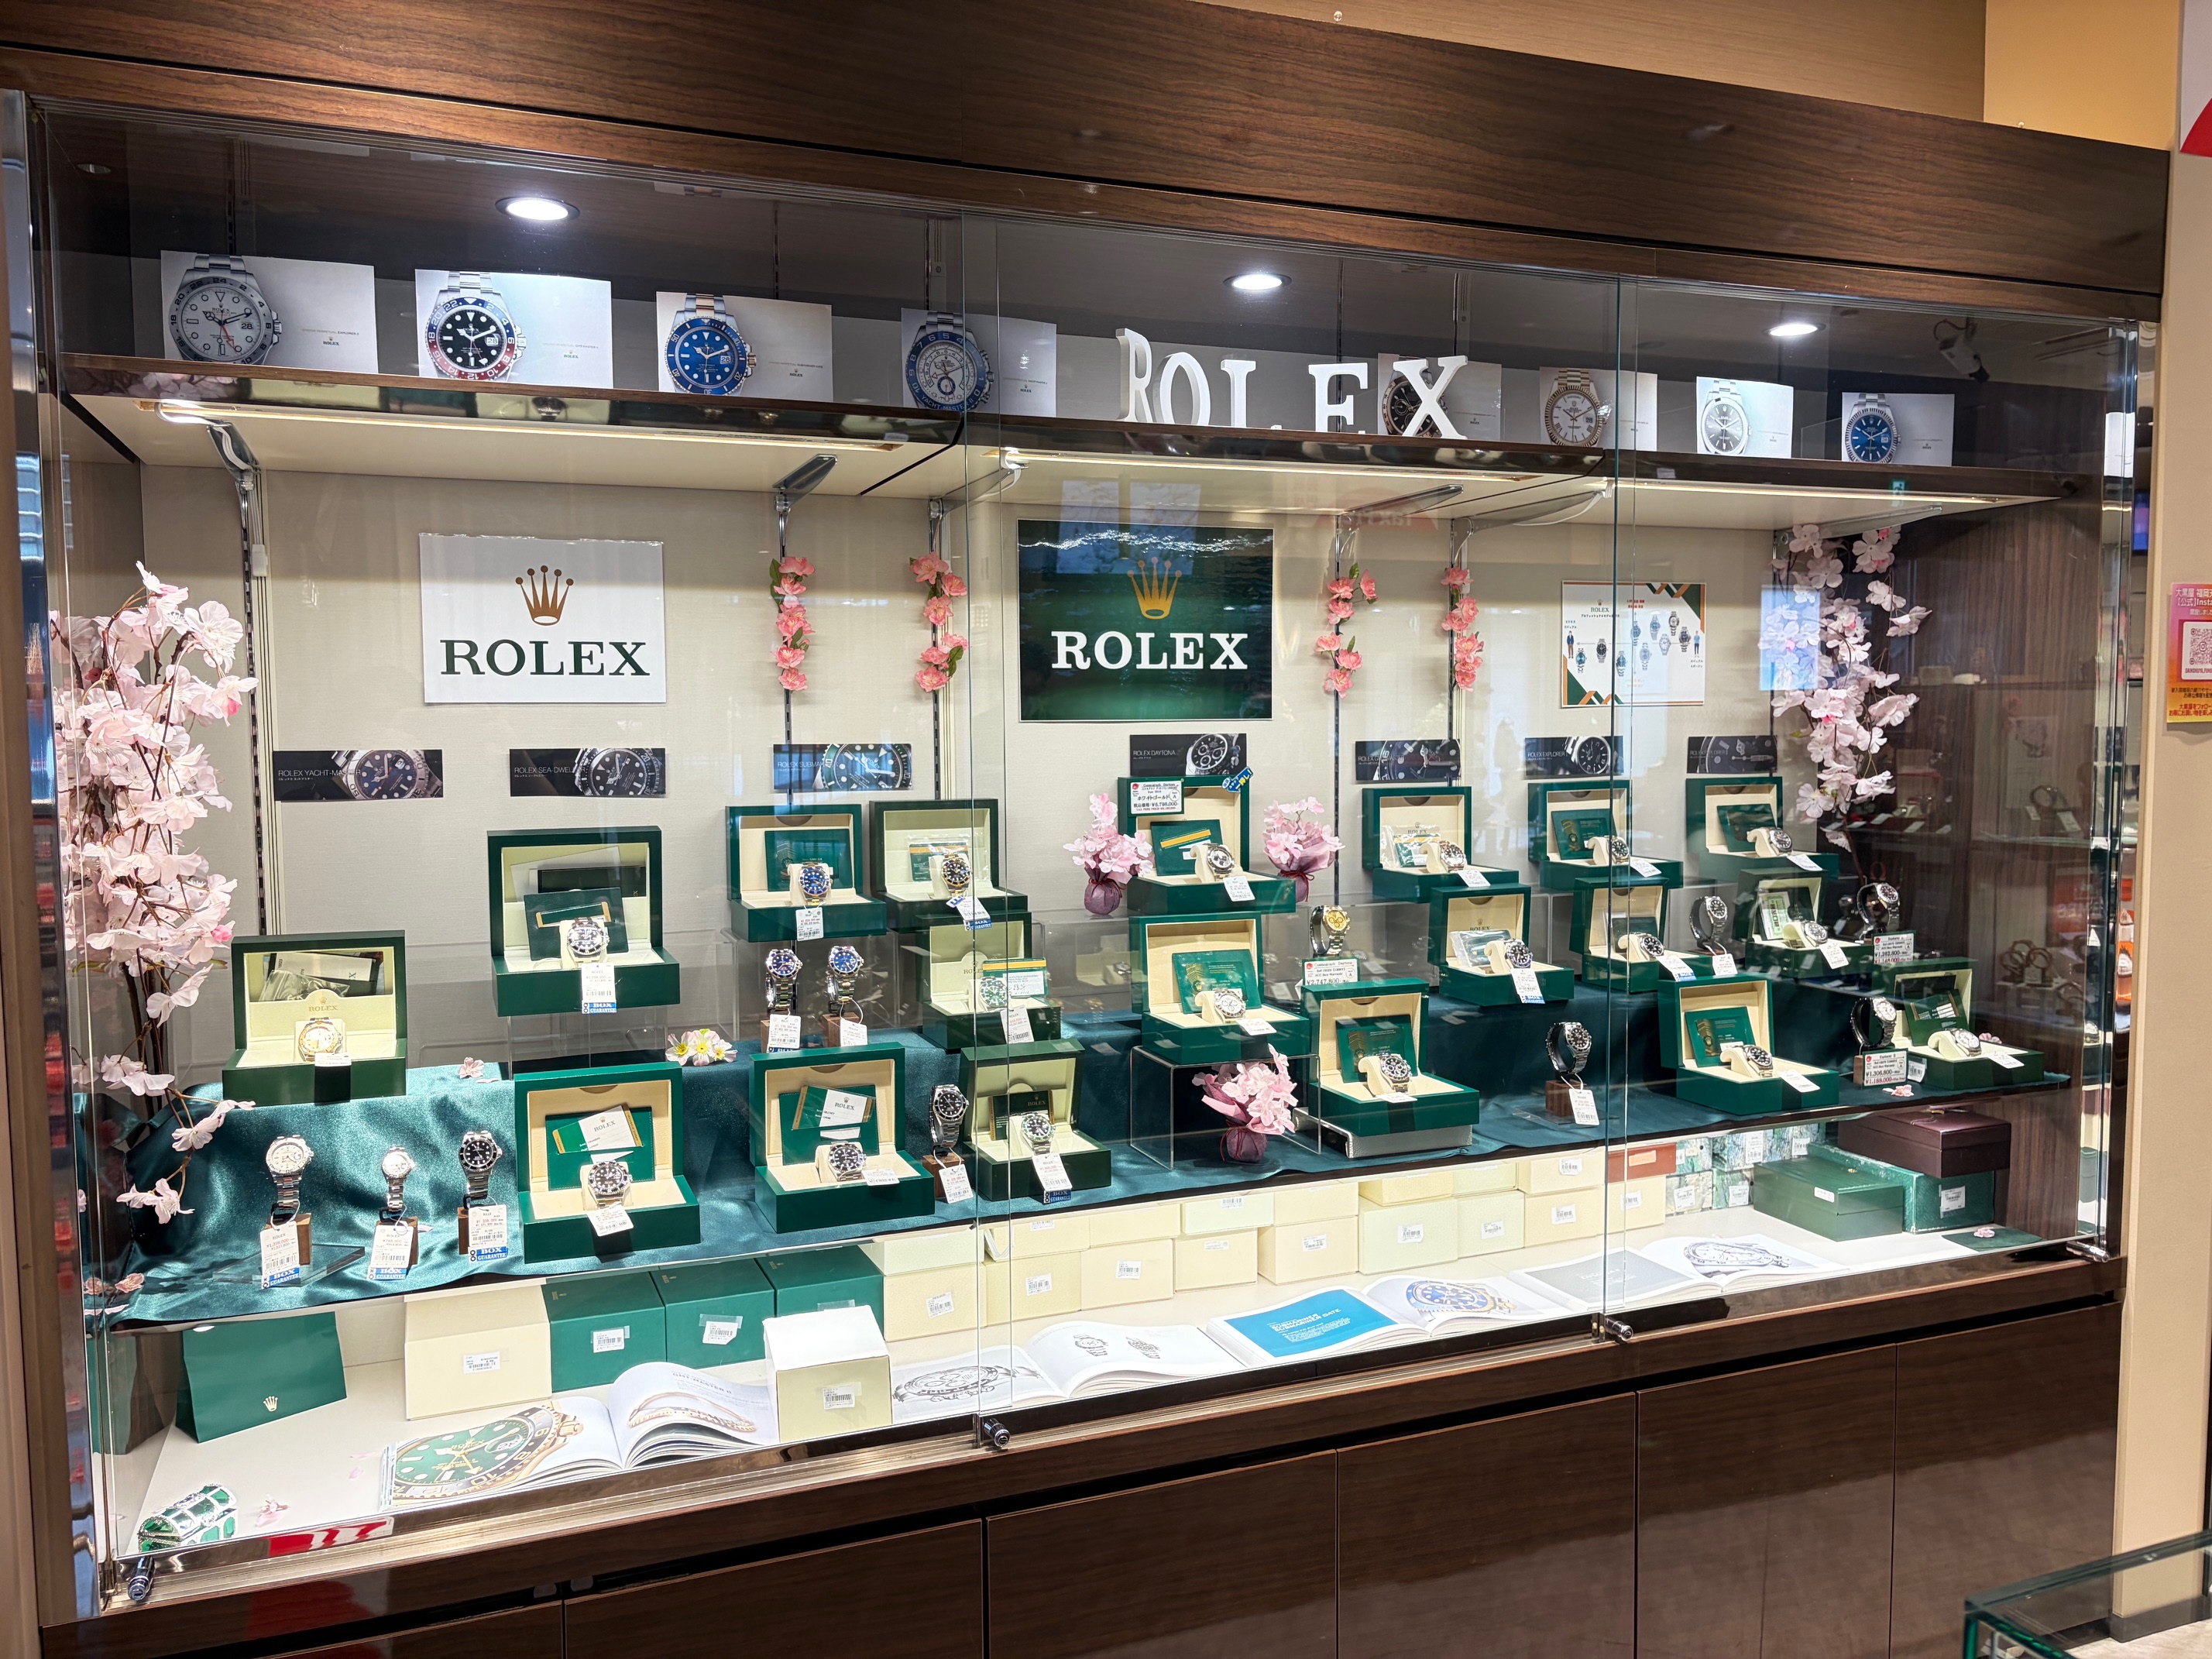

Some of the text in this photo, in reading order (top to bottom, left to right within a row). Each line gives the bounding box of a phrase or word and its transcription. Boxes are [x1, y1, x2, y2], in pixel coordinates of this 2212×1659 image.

[444, 300, 458, 310] 22
[1051, 630, 1249, 670] ROLEX
[440, 639, 651, 676] ROLEX
[835, 1102, 855, 1111] ROLEX
[593, 1120, 616, 1132] ROLEX
[273, 1268, 295, 1279] BOX
